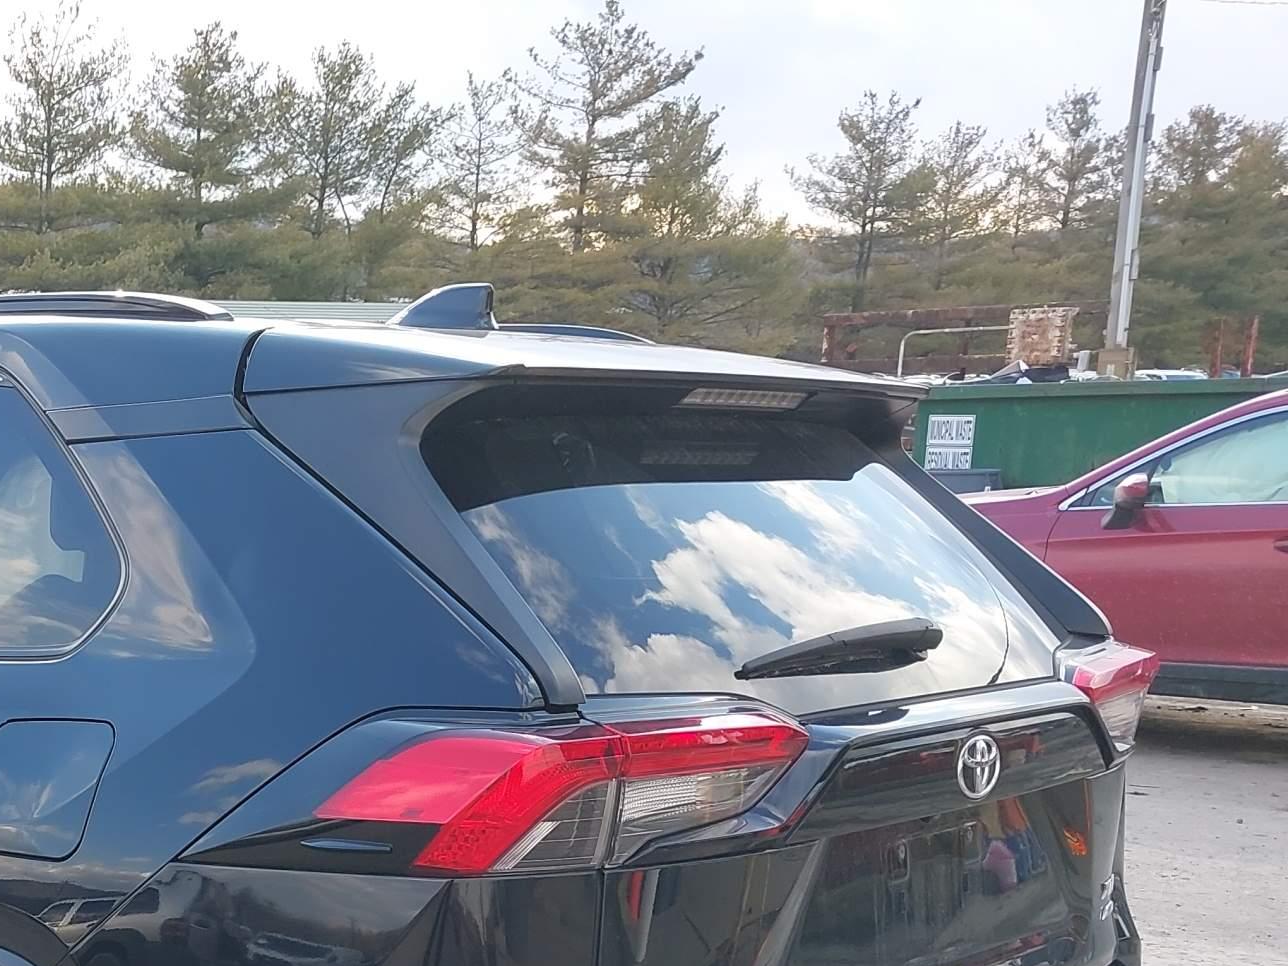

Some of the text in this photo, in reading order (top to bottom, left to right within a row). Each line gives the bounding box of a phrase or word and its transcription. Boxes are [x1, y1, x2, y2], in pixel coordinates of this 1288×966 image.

[929, 420, 973, 441] MUNICIPAL WASTE
[927, 451, 970, 469] RESIDUAL WASTE
